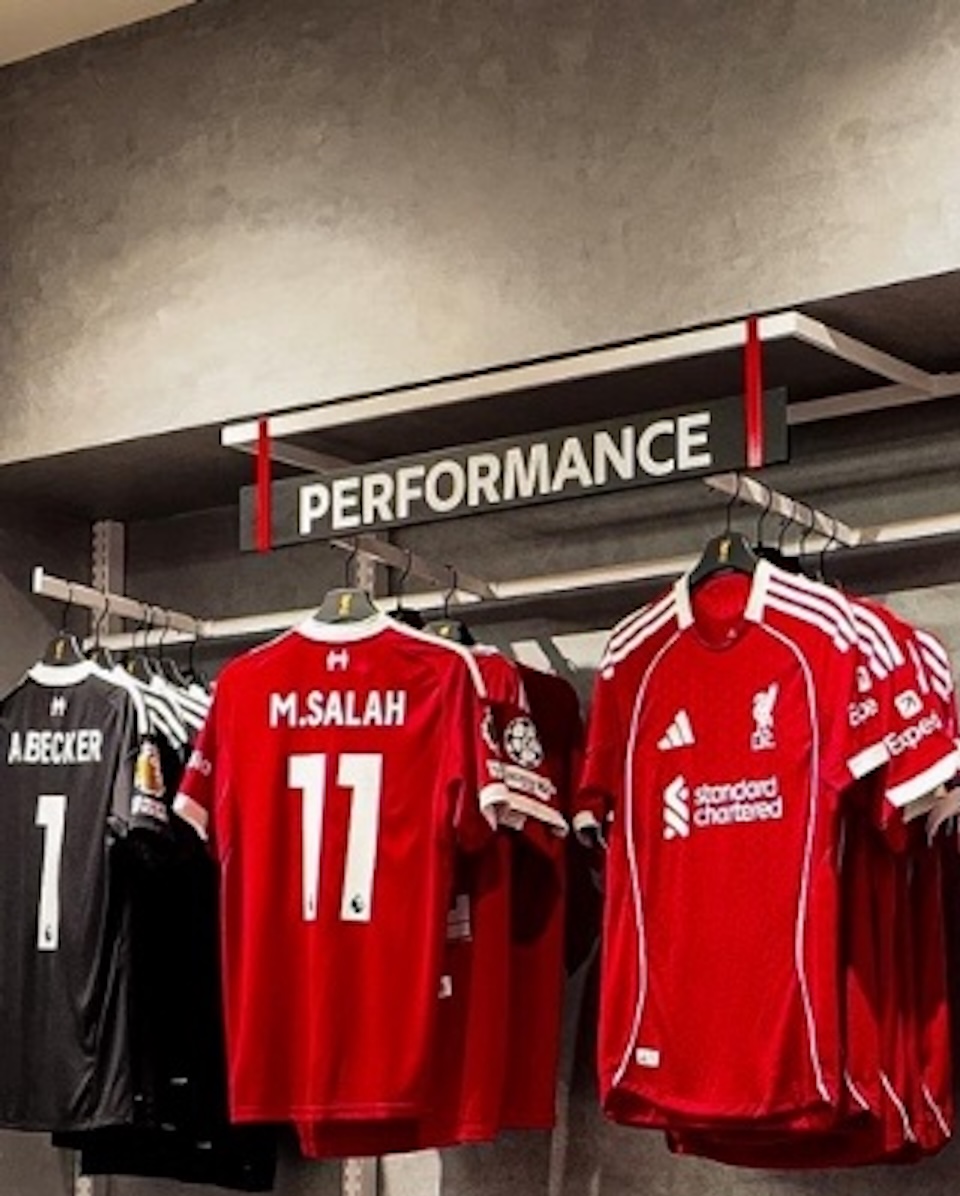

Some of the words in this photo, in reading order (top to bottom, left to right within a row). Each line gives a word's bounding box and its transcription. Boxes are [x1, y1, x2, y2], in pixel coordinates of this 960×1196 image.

[300, 412, 712, 534] PERFORMANCE
[268, 689, 408, 729] M.SALAH
[692, 795, 784, 828] chartered
[693, 774, 778, 808] standard
[35, 794, 68, 951] 1
[287, 752, 384, 922] 11
